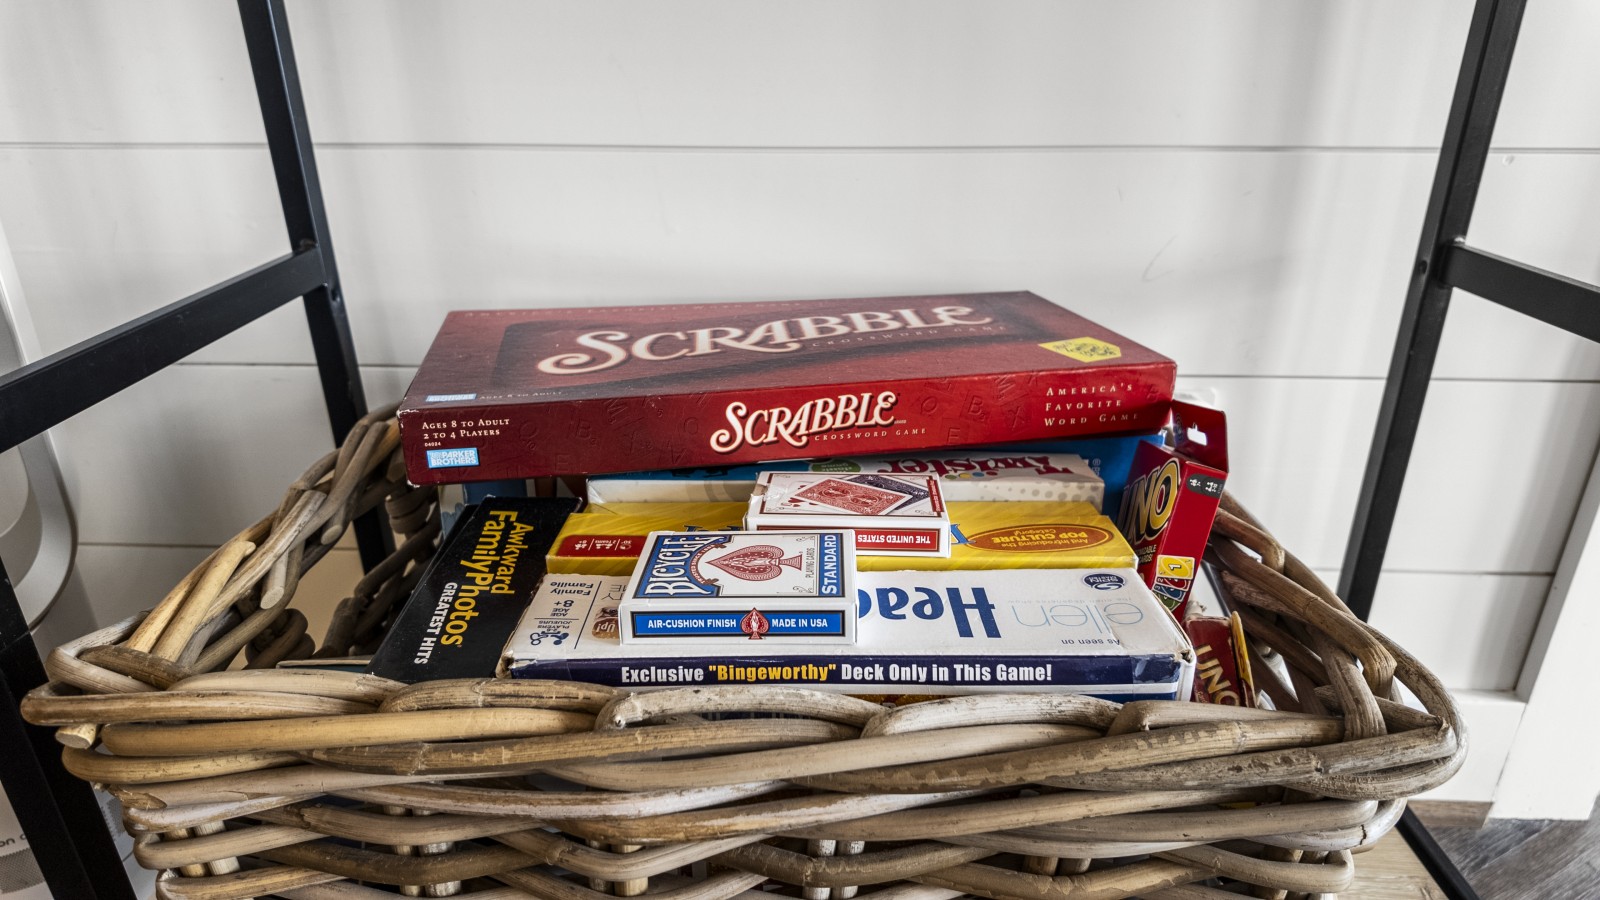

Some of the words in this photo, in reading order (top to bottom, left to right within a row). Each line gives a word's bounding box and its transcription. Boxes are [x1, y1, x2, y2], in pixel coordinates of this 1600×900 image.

[537, 305, 993, 375] SCRABBLE
[1046, 382, 1133, 397] AMERICA'S
[1045, 400, 1121, 412] FAVORITE
[451, 420, 457, 428] 8
[709, 391, 896, 453] SCRABBLE
[1044, 417, 1087, 427] WORD
[1099, 413, 1138, 422] GAME
[450, 431, 456, 439] 4
[815, 431, 888, 441] CROSSWORD
[896, 428, 927, 436] GAME
[442, 450, 475, 458] PARKER
[431, 457, 477, 466] BROTHERS
[877, 456, 1074, 478] Twister
[857, 534, 884, 542] STATES
[887, 536, 914, 544] UNITED
[992, 532, 1056, 544] CULTURE
[490, 521, 534, 595] Awkward
[807, 547, 815, 559] CARDS
[643, 534, 721, 596] BICYCLE
[805, 559, 814, 579] PLAYING
[821, 534, 837, 595] STANDARD
[550, 581, 594, 589] Famille
[550, 588, 591, 596] Family
[426, 582, 458, 635] GREATEST
[553, 600, 574, 608] 8+
[648, 618, 705, 629] AIR-CUSHION
[707, 618, 737, 628] FINISH
[771, 618, 797, 628] MADE
[799, 618, 808, 628] IN
[810, 618, 828, 628] USA
[1012, 602, 1144, 634] ellen
[596, 623, 616, 633] Up!
[414, 637, 436, 665] HITS
[621, 666, 704, 683] Exclusive
[708, 664, 837, 683] "Bingeworthy"
[842, 664, 885, 680] Deck
[889, 663, 929, 682] Only
[932, 663, 949, 680] in
[953, 663, 991, 680] This
[995, 663, 1052, 681] Game!
[1196, 645, 1240, 706] UNO
